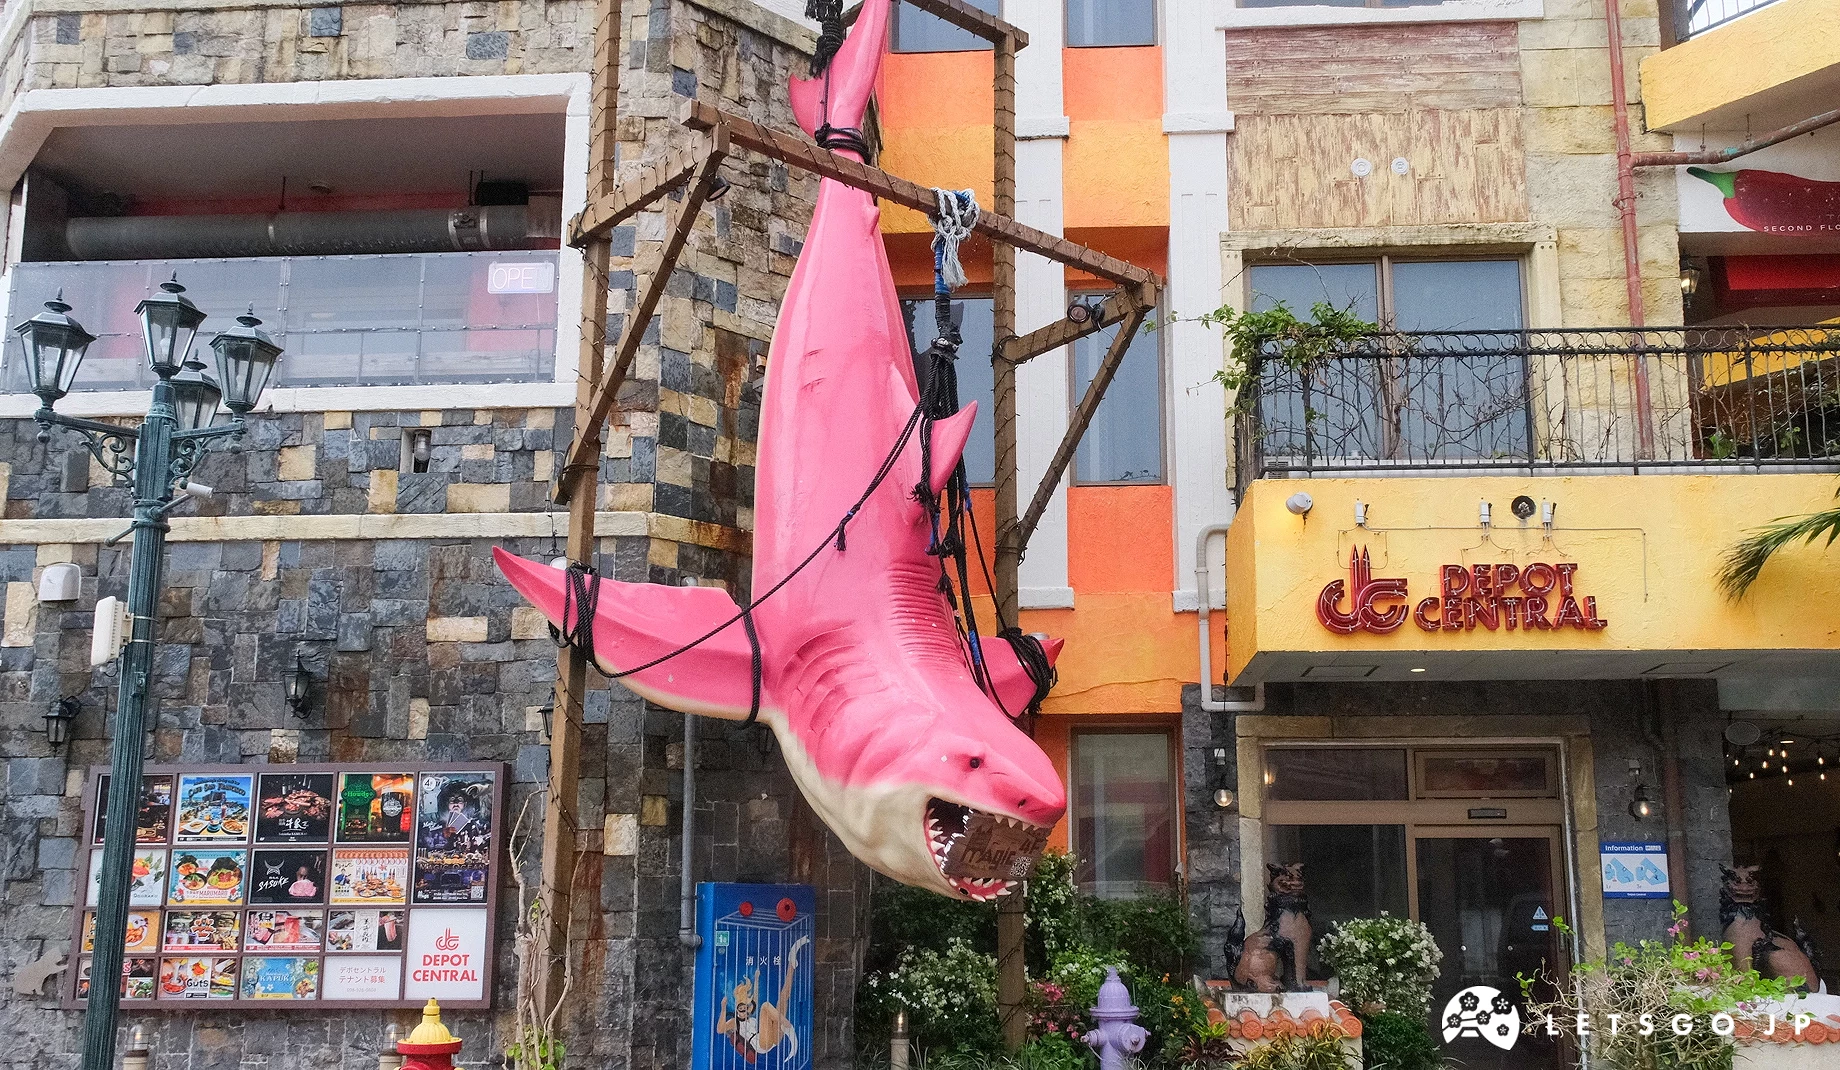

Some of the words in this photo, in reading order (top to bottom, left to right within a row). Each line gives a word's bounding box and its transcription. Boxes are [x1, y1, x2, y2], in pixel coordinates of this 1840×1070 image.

[1440, 563, 1578, 599] DEPOT
[1413, 596, 1608, 632] CENTRAL
[422, 954, 470, 967] DEPOT
[745, 956, 781, 966] 消火栓
[412, 969, 478, 982] CENTRAL
